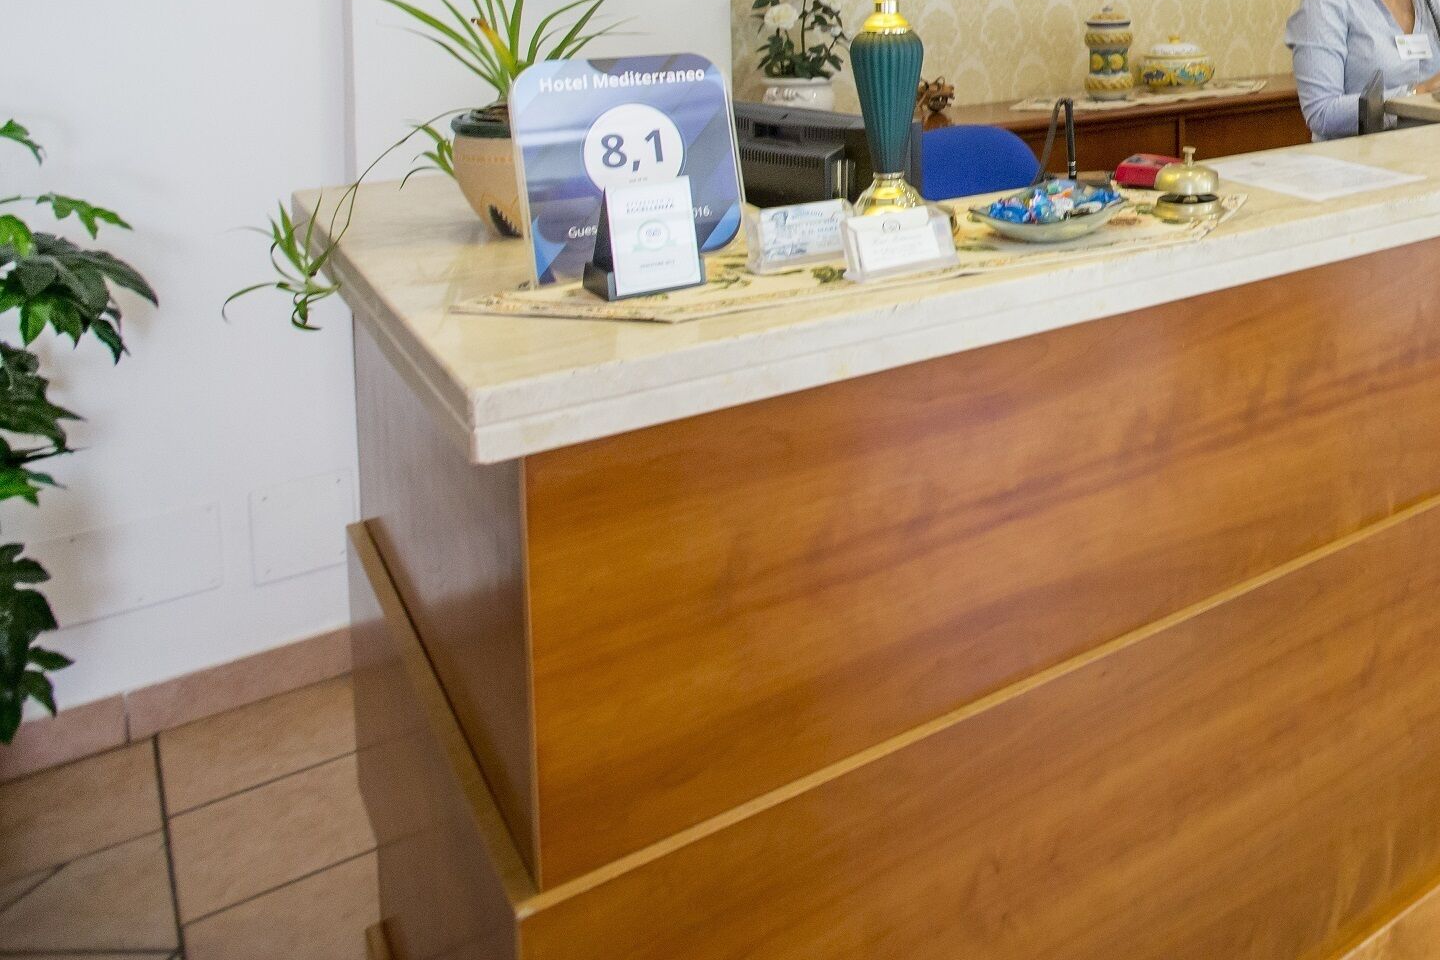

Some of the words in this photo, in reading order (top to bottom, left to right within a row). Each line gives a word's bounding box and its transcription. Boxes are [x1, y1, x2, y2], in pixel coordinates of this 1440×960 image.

[539, 73, 588, 93] Hotel
[593, 68, 705, 89] Mediterraneo
[600, 129, 665, 173] 8,1
[568, 225, 598, 239] Gues
